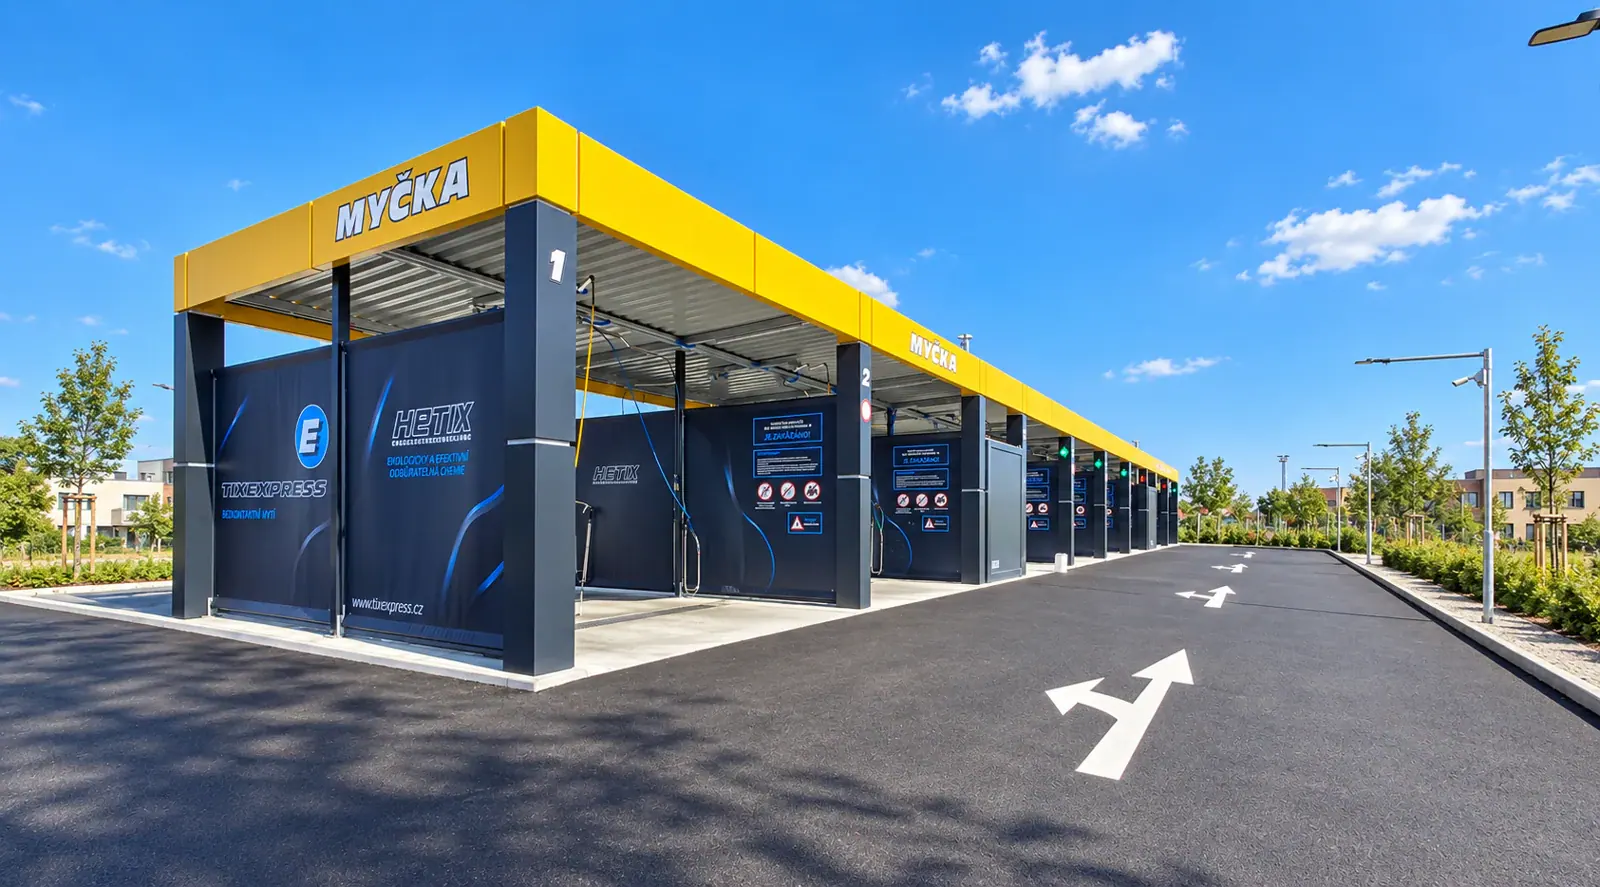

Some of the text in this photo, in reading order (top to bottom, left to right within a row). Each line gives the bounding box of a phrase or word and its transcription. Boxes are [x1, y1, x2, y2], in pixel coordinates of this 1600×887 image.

[335, 156, 470, 242] MYČKA
[549, 248, 567, 284] 1
[910, 332, 957, 374] MYČKA
[862, 367, 871, 388] 2
[299, 418, 323, 456] E
[593, 464, 640, 481] HETIX
[222, 480, 327, 498] TIXEXPRESS
[352, 598, 424, 615] www.tixexpress.cz
